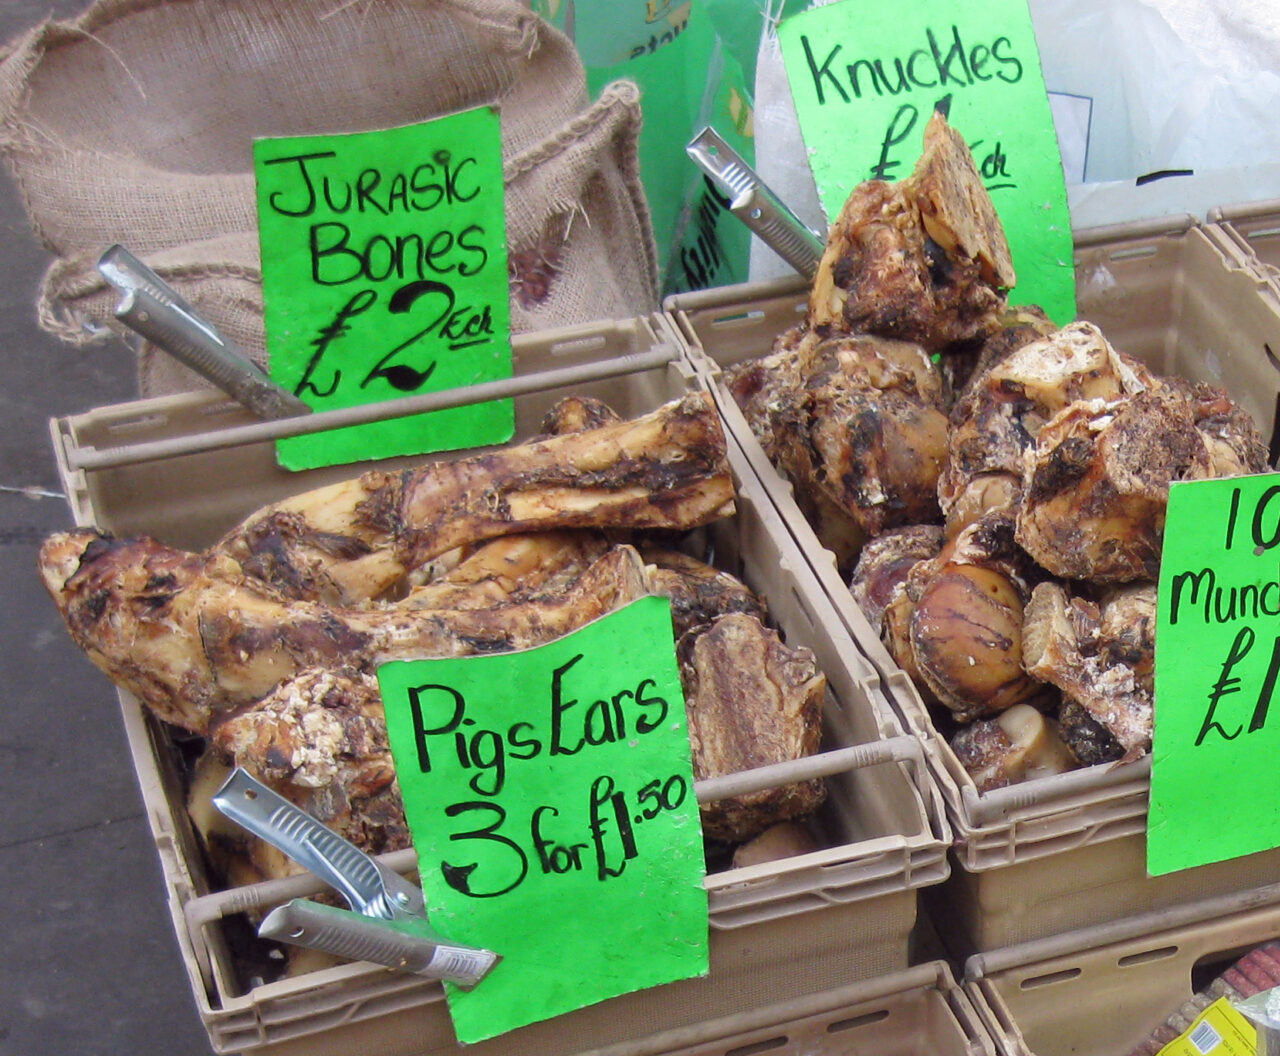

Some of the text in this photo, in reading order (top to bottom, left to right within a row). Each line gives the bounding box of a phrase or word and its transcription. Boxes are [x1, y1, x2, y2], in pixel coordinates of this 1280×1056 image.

[802, 26, 1022, 104] Knuckles
[310, 222, 488, 286] Bones
[294, 281, 455, 397] £2
[408, 653, 668, 796] Pigs Ears
[441, 774, 687, 897] 3 for £1.50
